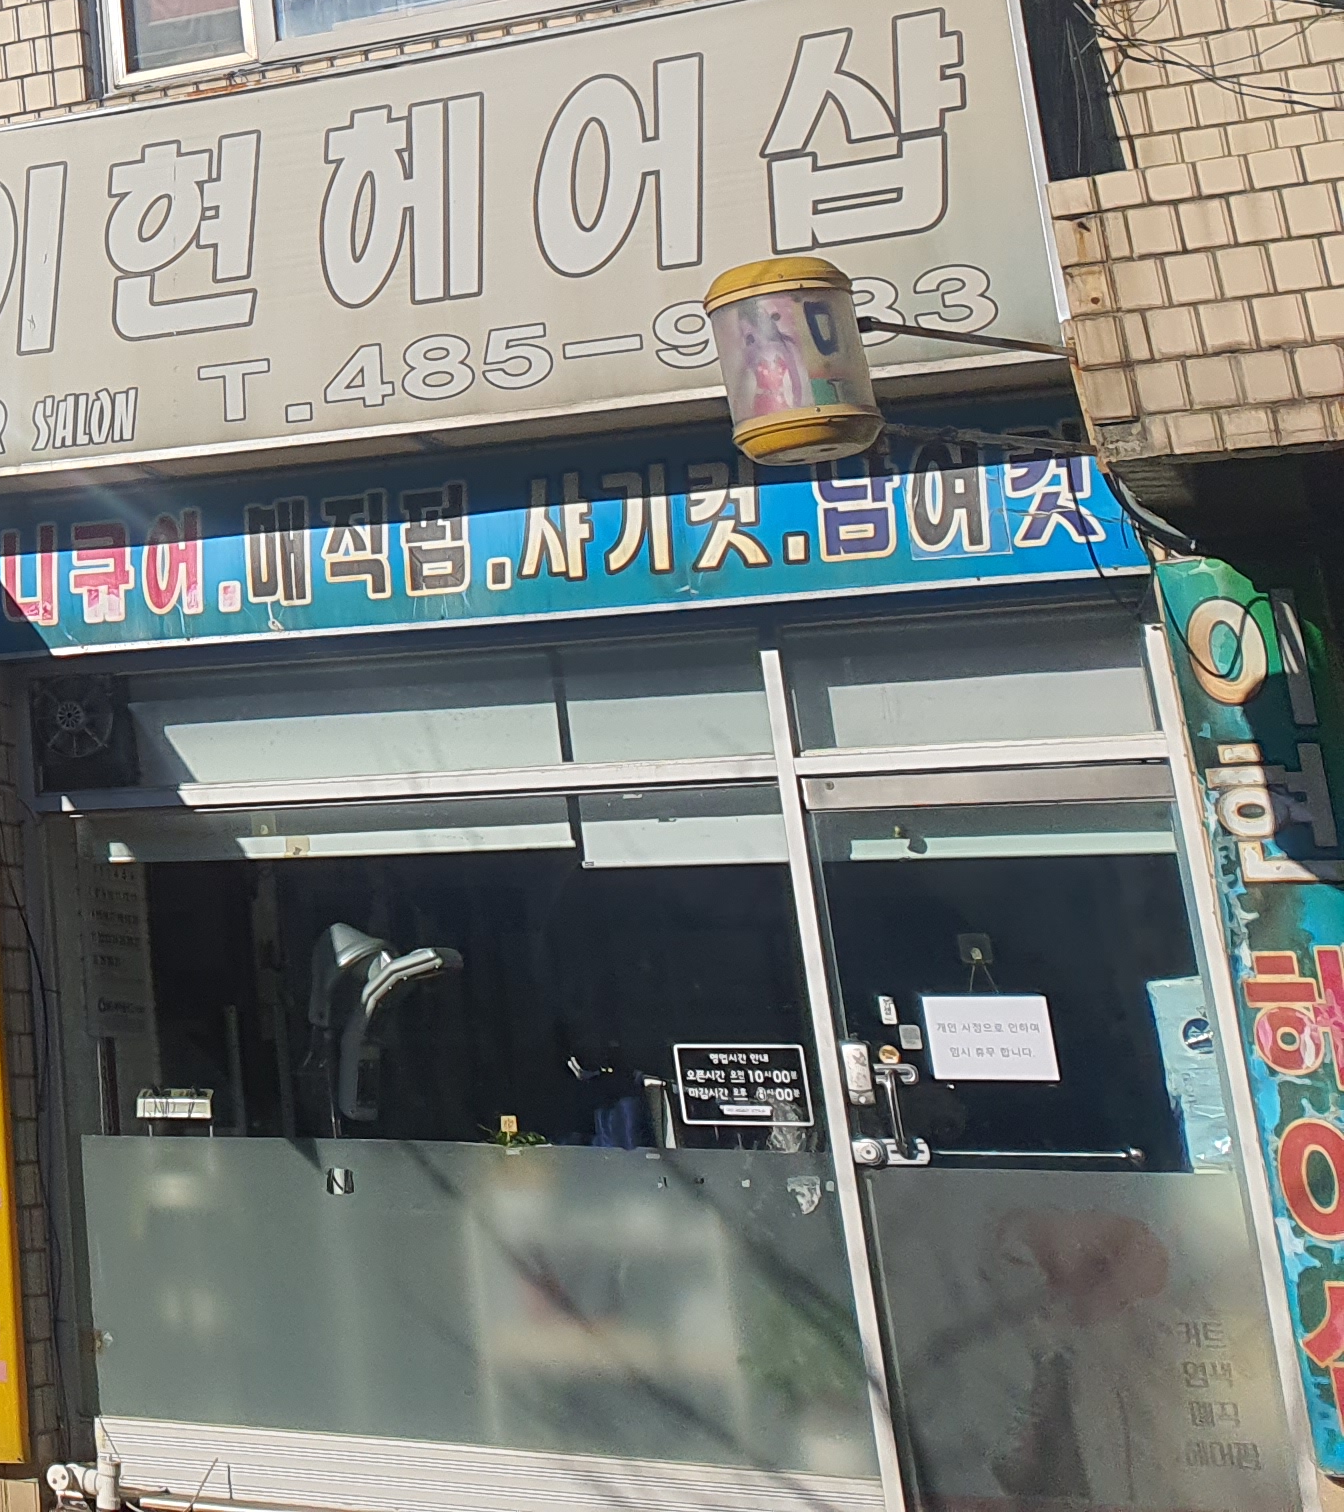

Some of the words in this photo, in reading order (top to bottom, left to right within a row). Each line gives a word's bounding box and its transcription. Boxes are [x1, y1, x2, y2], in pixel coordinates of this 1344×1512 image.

[31, 387, 139, 452] SALON
[936, 1022, 958, 1034] 개인
[961, 1022, 1004, 1034] 사정으로
[1007, 1022, 1041, 1034] 인하여
[708, 1052, 747, 1065] 영업시간
[749, 1052, 770, 1065] 안내
[949, 1046, 971, 1058] 임시
[686, 1069, 726, 1083] 오픈시간
[688, 1087, 729, 1100] 마감시간
